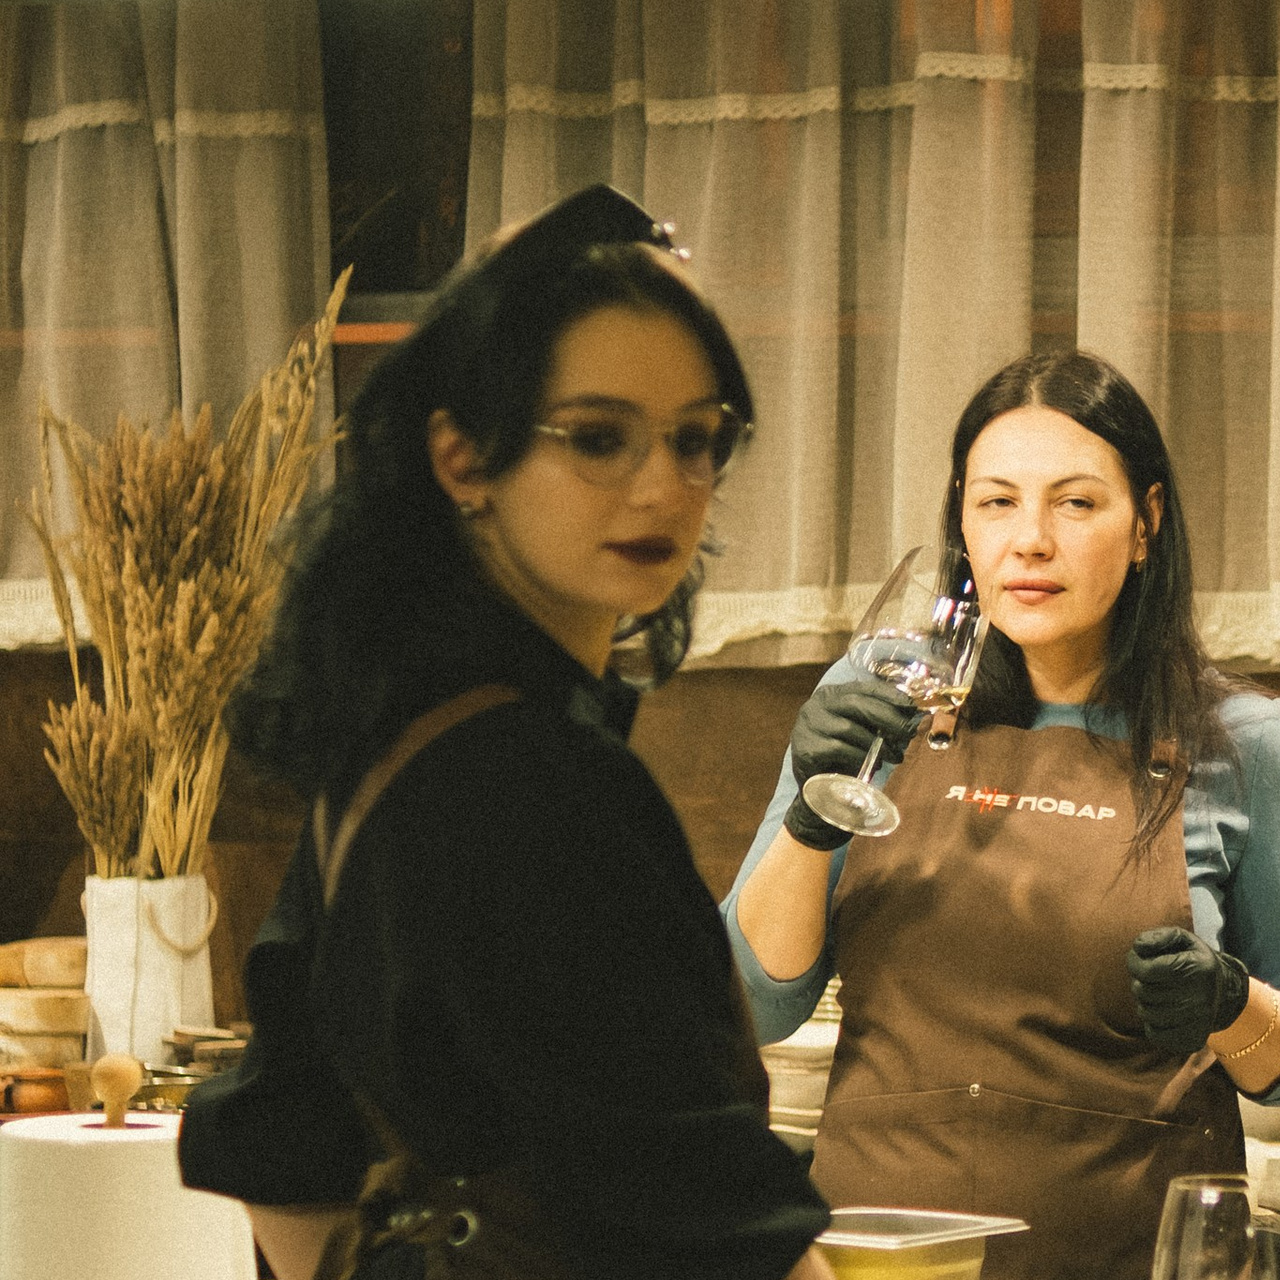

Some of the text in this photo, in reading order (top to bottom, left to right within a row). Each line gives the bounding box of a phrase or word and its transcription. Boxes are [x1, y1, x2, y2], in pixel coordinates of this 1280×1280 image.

[945, 786, 1116, 821] Я НЕ ПОВАР
